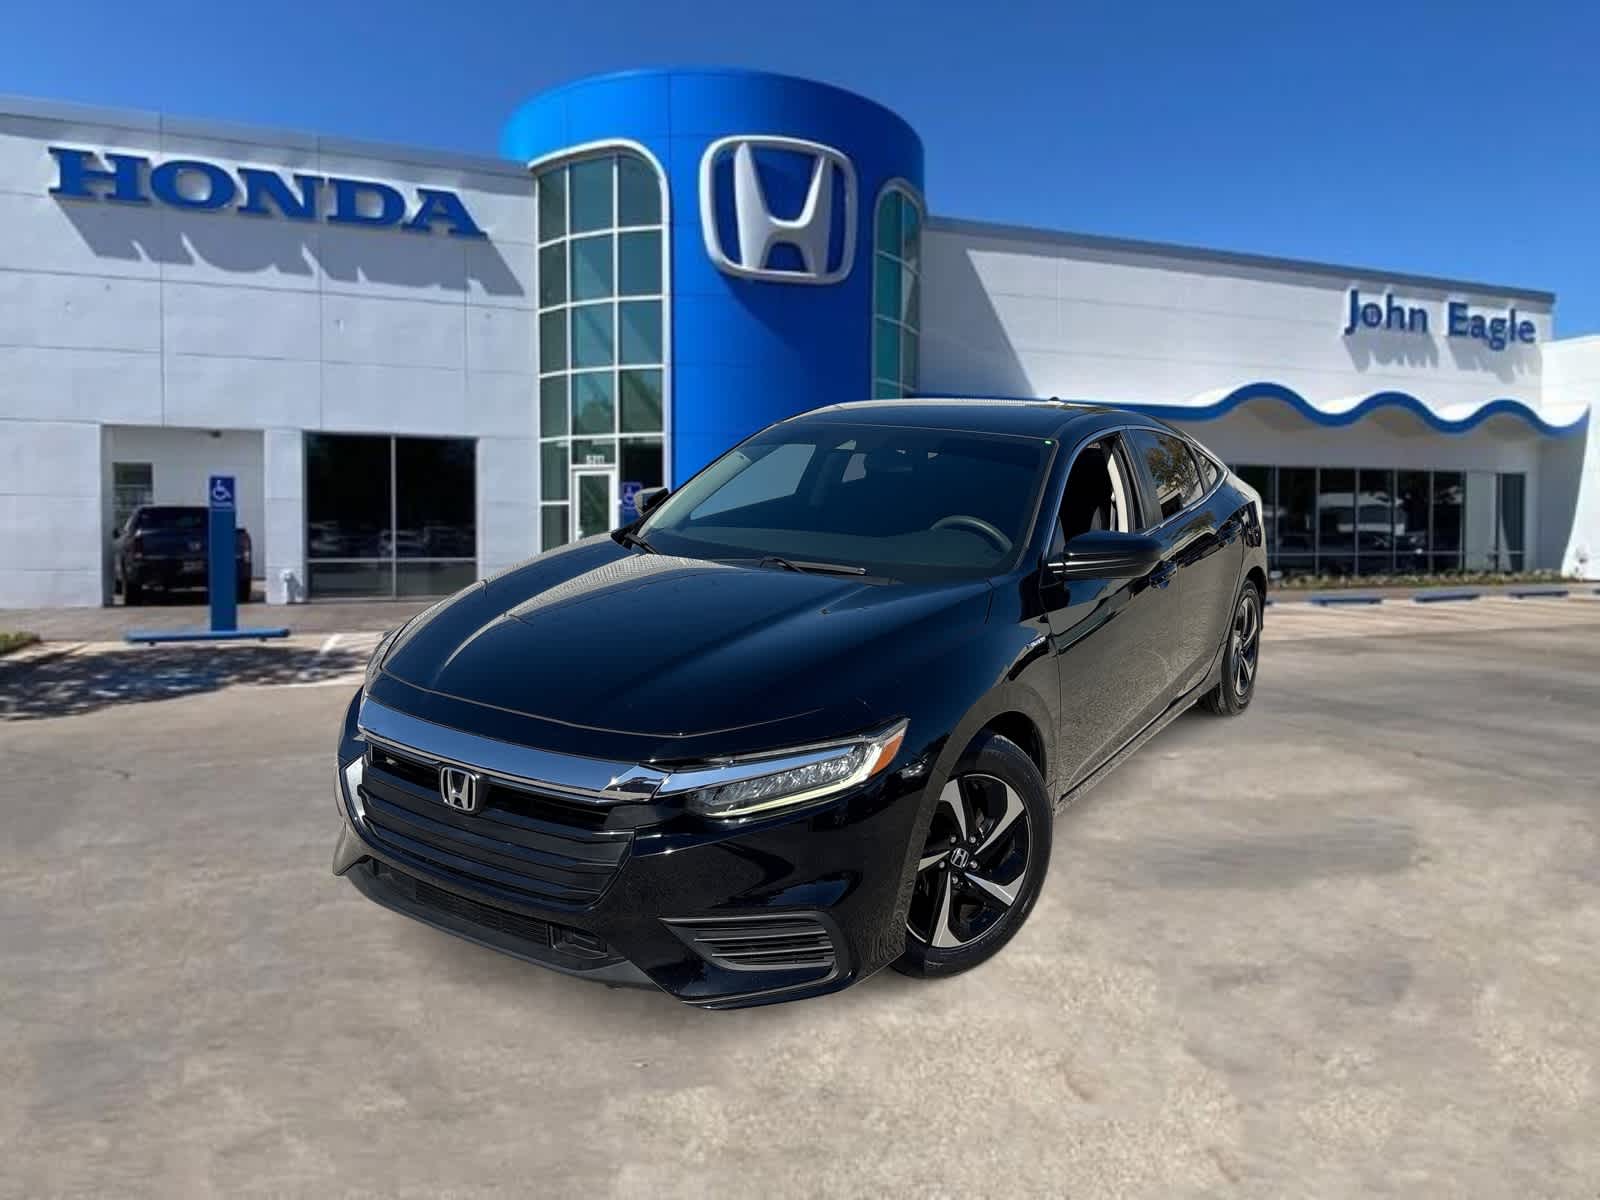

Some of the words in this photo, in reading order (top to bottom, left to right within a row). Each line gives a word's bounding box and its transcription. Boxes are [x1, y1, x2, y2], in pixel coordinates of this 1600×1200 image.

[47, 145, 488, 241] HONDA
[1344, 288, 1429, 336] John
[1447, 300, 1537, 351] Eagle
